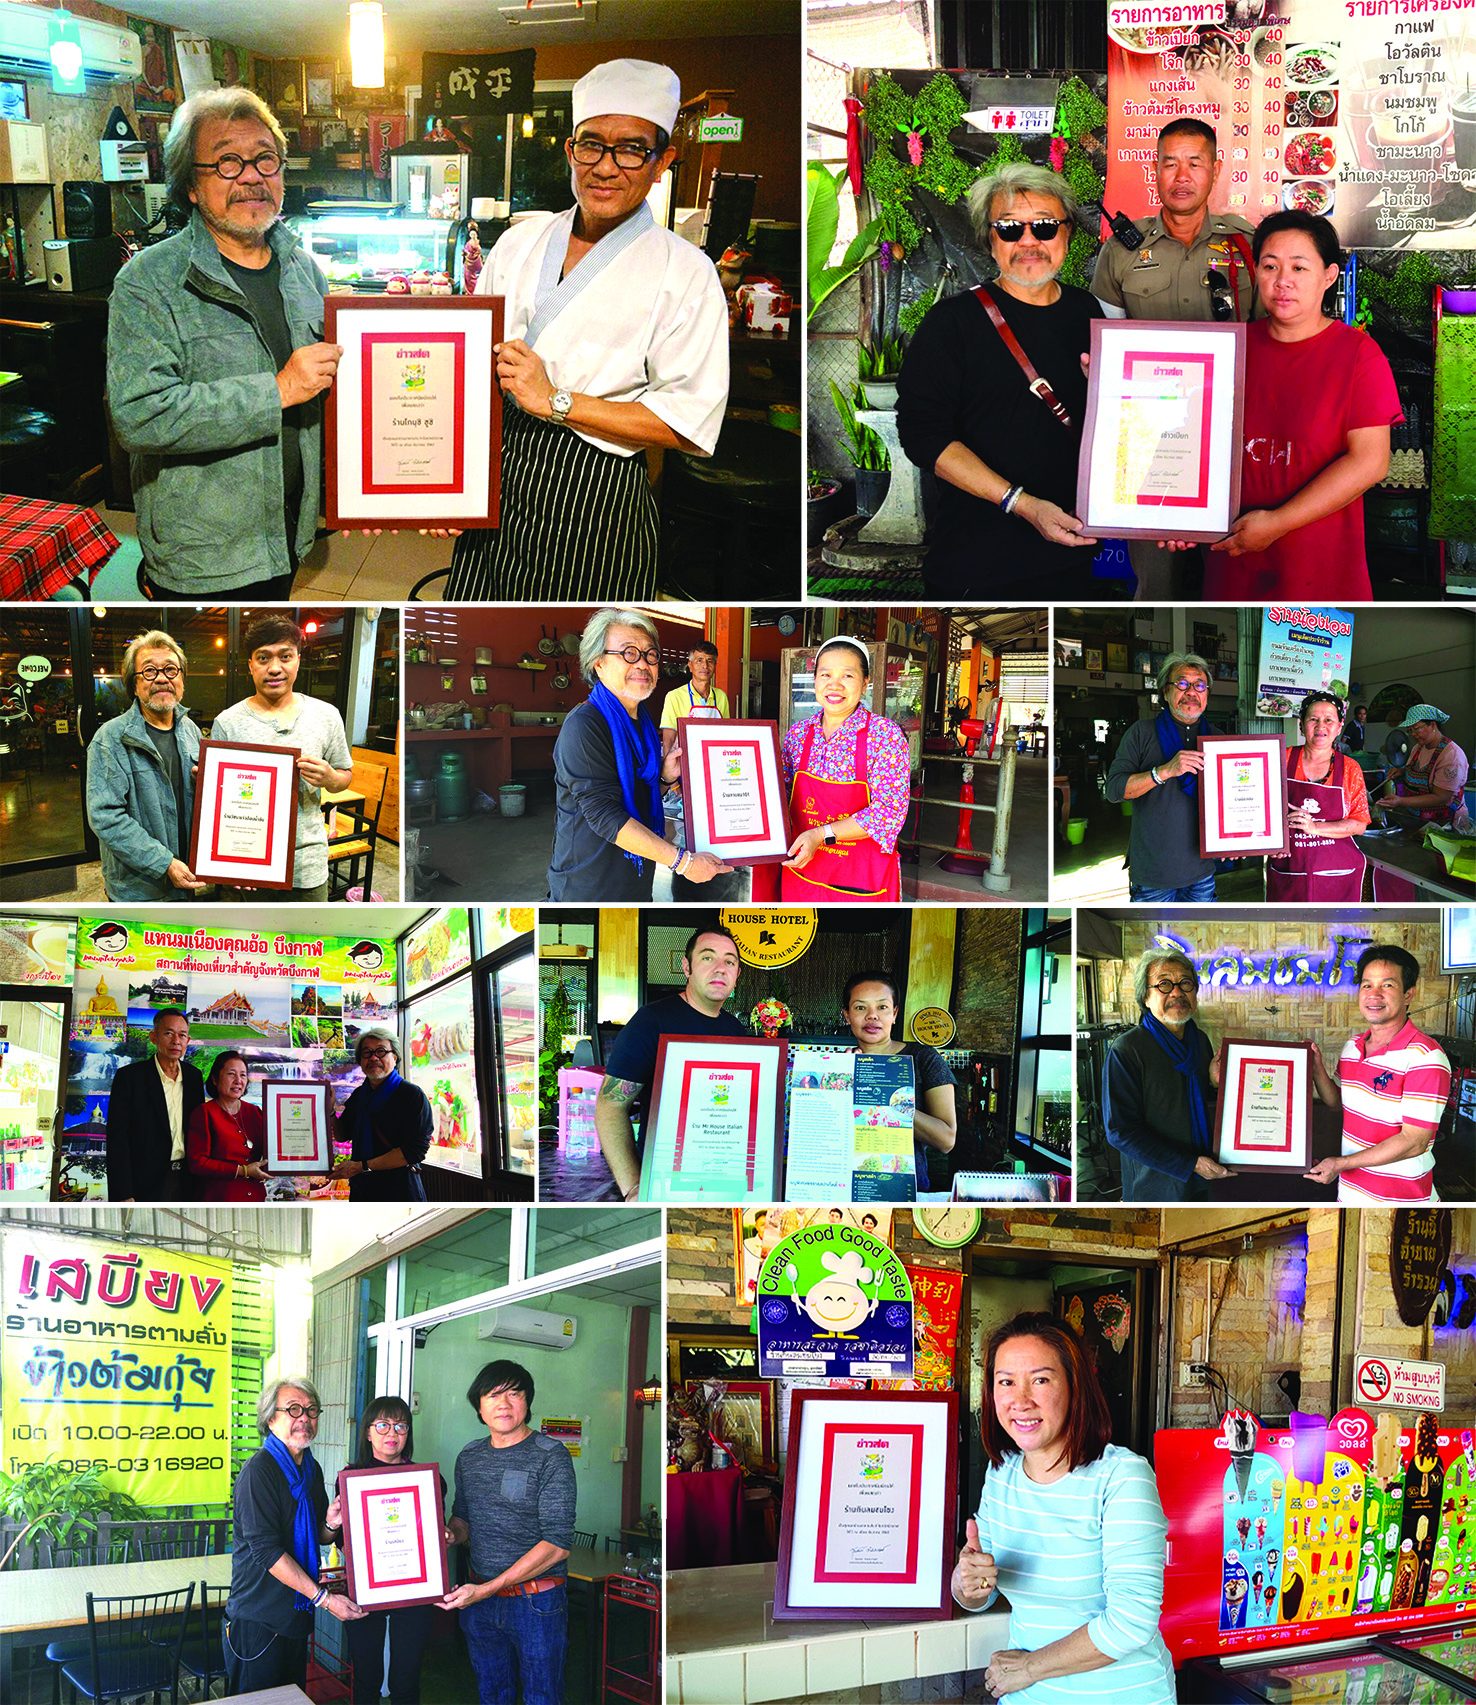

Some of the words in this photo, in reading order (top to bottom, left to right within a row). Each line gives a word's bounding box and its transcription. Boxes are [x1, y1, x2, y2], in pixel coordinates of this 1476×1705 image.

[1111, 3, 1225, 23] รายการอาหาร
[1395, 19, 1434, 34] กาแฟ
[1146, 31, 1199, 47] ข้าวเปียก
[1234, 30, 1250, 43] 30
[1266, 29, 1282, 41] 40
[1161, 51, 1183, 69] โจ๊ก
[1234, 55, 1250, 66] 30
[1265, 53, 1282, 65] 40
[1385, 42, 1441, 60] โอวัลติน
[1150, 77, 1195, 93] แกงเส้น
[1234, 78, 1250, 90] 30
[1265, 77, 1281, 89] 40
[1379, 67, 1445, 85] ชาโบราณ
[1124, 98, 1220, 119] ข้าวต้มซี่โครงหมู
[1234, 102, 1249, 113] 30
[1264, 101, 1280, 113] 40
[1385, 96, 1437, 114] นมชมพู
[1021, 111, 1049, 119] TOILET
[1394, 115, 1425, 133] โกโก้
[1264, 125, 1280, 136] 40
[1376, 144, 1441, 158] ชามะนาว
[1231, 171, 1247, 182] 30
[1263, 171, 1278, 182] 40
[1383, 184, 1431, 206] โอเลี้ยง
[1376, 208, 1435, 229] น้ำอัดลม
[1268, 607, 1351, 636] รานน้องเอม
[728, 914, 766, 924] HOUSE
[771, 915, 809, 925] HOTEL
[144, 929, 267, 959] แหนมเนืองคุณอ้อ
[274, 935, 324, 957] บึงกาฬ
[732, 934, 757, 957] ITALIAN
[759, 936, 804, 960] RESTAURANT
[156, 954, 320, 979] สถานที่ท่องเที่ยวสำคัญจังหวัดบึงกาฬ
[762, 1248, 794, 1293] Clean
[791, 1226, 834, 1250] Food
[840, 1227, 885, 1258] Good
[883, 1255, 906, 1299] Taste
[19, 1253, 223, 1314] เสบียง
[6, 1304, 227, 1346] ร้านอาหารตามสั่ง
[1393, 1366, 1440, 1387] ห้ามสูบบุหรี่
[1393, 1392, 1404, 1404] NO
[12, 1425, 47, 1441] เปิด
[63, 1426, 205, 1440] 10.00-22.00
[213, 1428, 229, 1440] น.
[58, 1457, 224, 1474] 086-0316920
